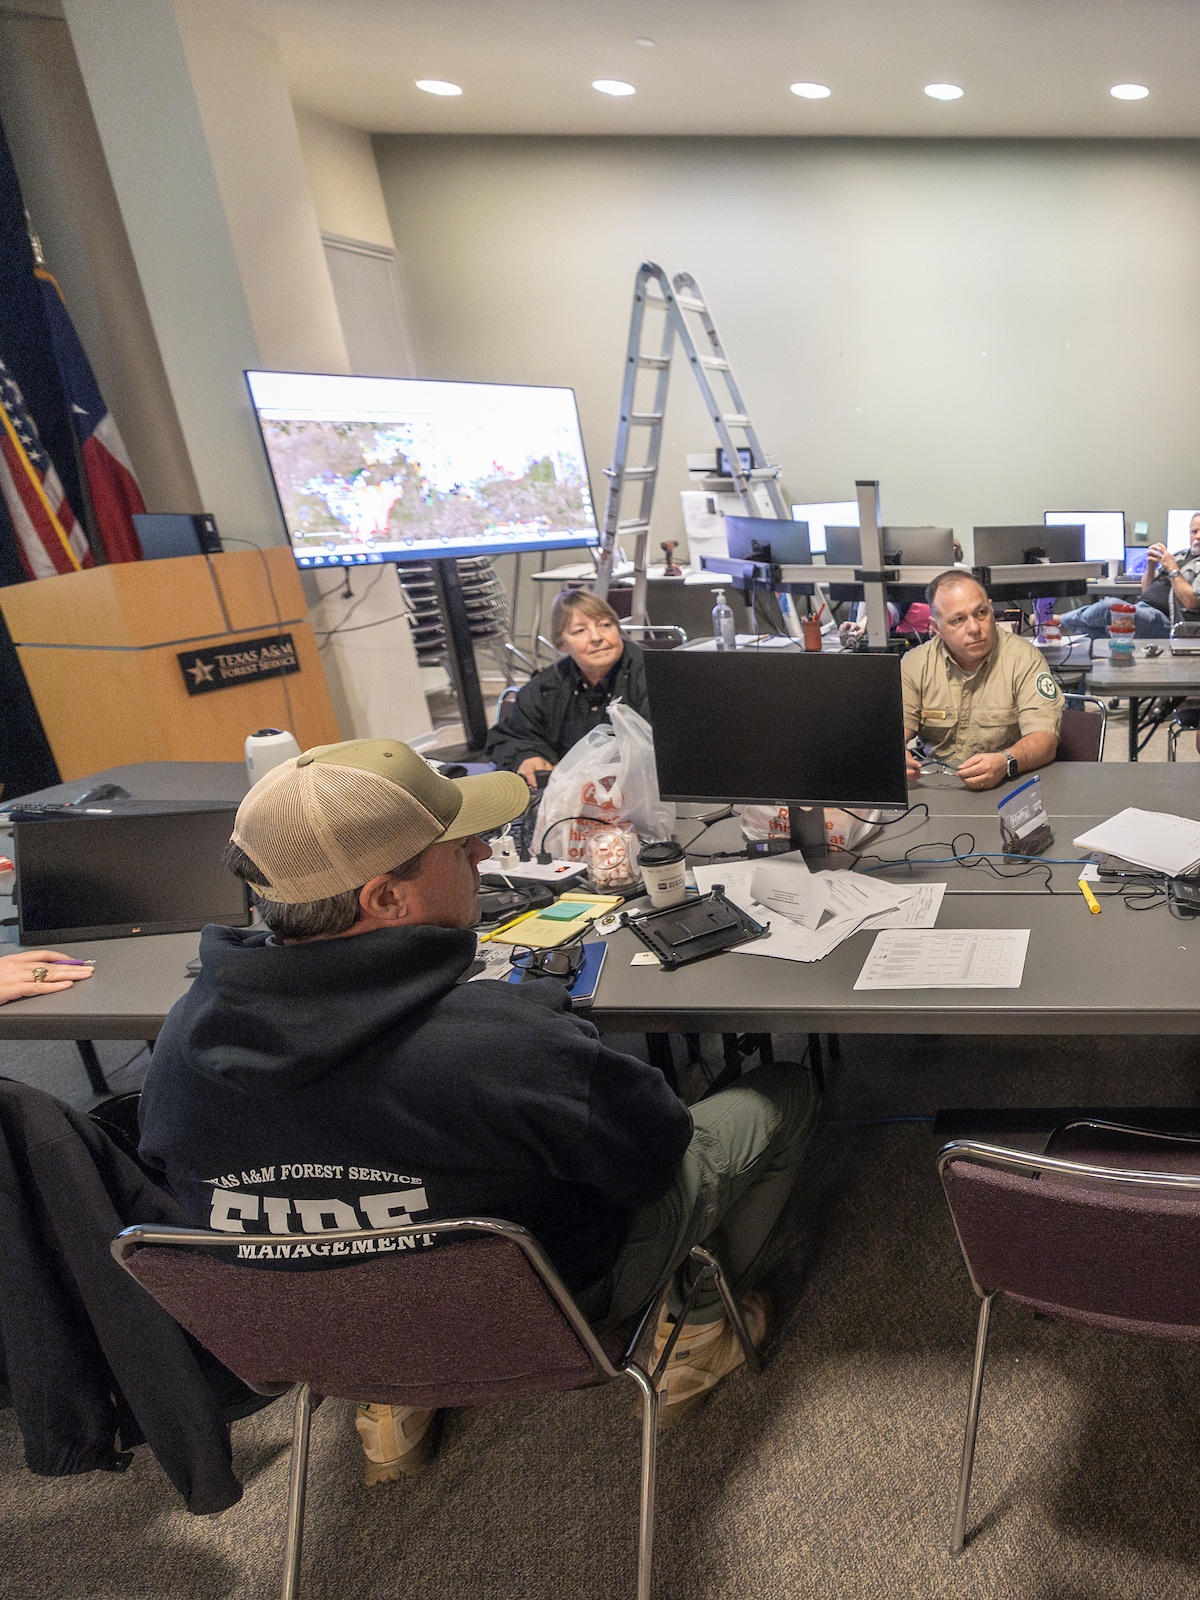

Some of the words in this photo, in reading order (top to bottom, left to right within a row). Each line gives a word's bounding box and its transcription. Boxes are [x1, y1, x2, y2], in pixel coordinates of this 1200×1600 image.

[214, 650, 259, 668] TEXAS
[241, 1166, 276, 1184] A&M
[280, 1164, 344, 1180] FOREST
[348, 1166, 423, 1186] SERVICE
